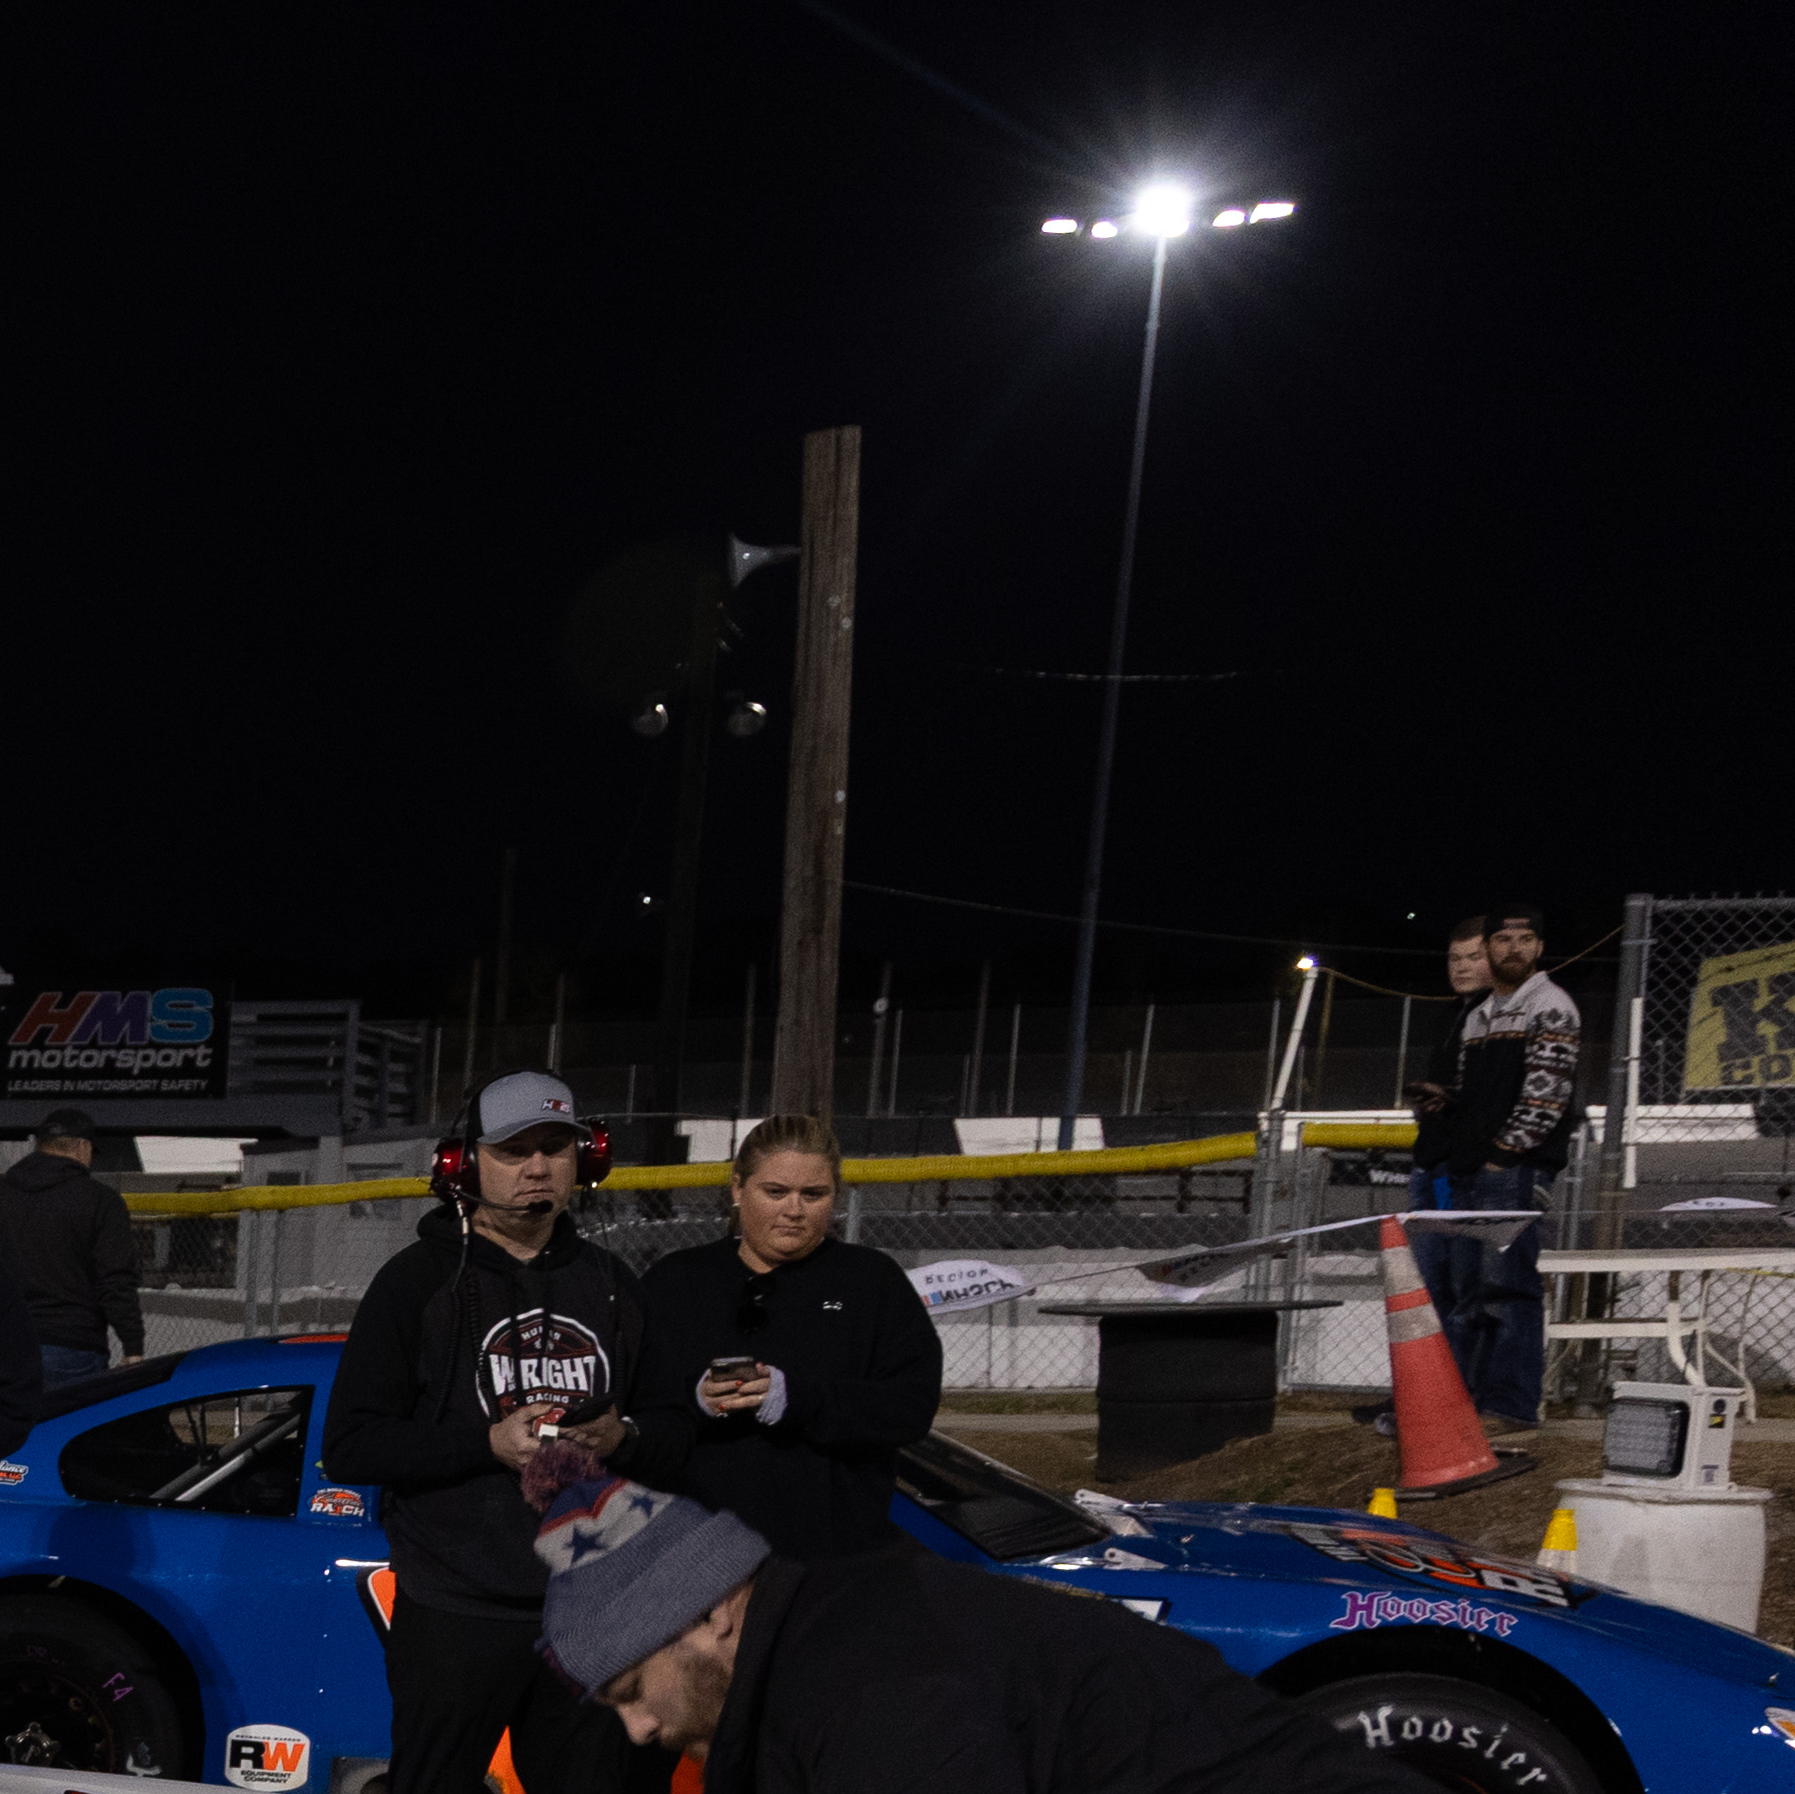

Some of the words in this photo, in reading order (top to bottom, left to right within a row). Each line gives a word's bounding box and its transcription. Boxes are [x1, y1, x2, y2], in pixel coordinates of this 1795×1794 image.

[8, 987, 214, 1046] HMS
[8, 1045, 212, 1075] motorsport
[526, 1391, 570, 1405] RACING
[1330, 1591, 1519, 1638] Hoosier
[230, 1738, 306, 1773] RW
[1355, 1703, 1548, 1787] Hoosier
